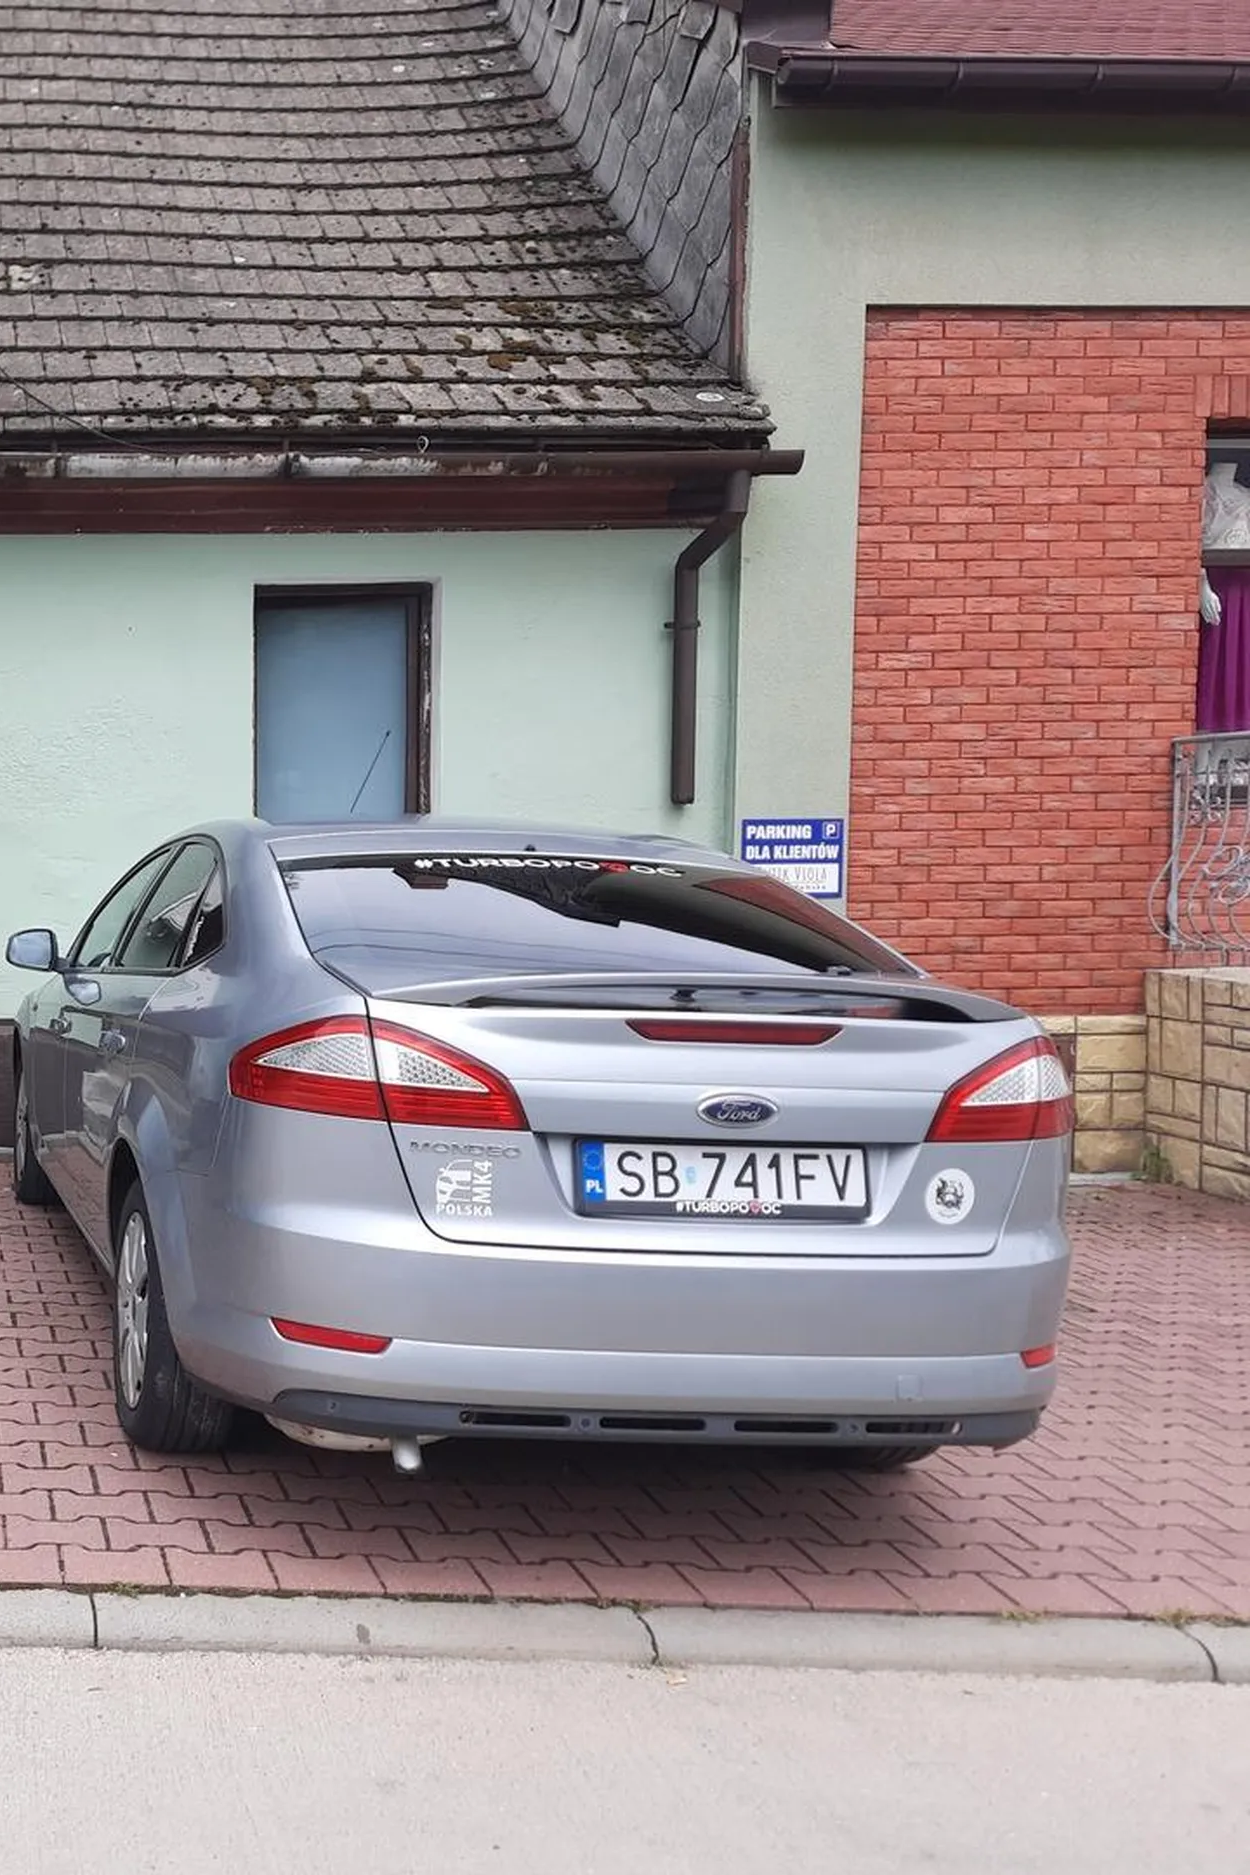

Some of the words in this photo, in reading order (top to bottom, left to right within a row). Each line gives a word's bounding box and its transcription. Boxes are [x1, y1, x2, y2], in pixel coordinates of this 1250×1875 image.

[746, 824, 813, 840] PARKING
[825, 824, 836, 837] P
[745, 845, 771, 860] DLA
[773, 841, 840, 860] KLIENTÓW
[717, 1099, 762, 1121] Ford
[410, 1140, 521, 1159] MONDEO
[471, 1160, 492, 1204] MK4
[616, 1150, 681, 1199] SB
[701, 1151, 853, 1202] 741FV
[586, 1180, 604, 1194] PL
[435, 1203, 493, 1217] POLSKA
